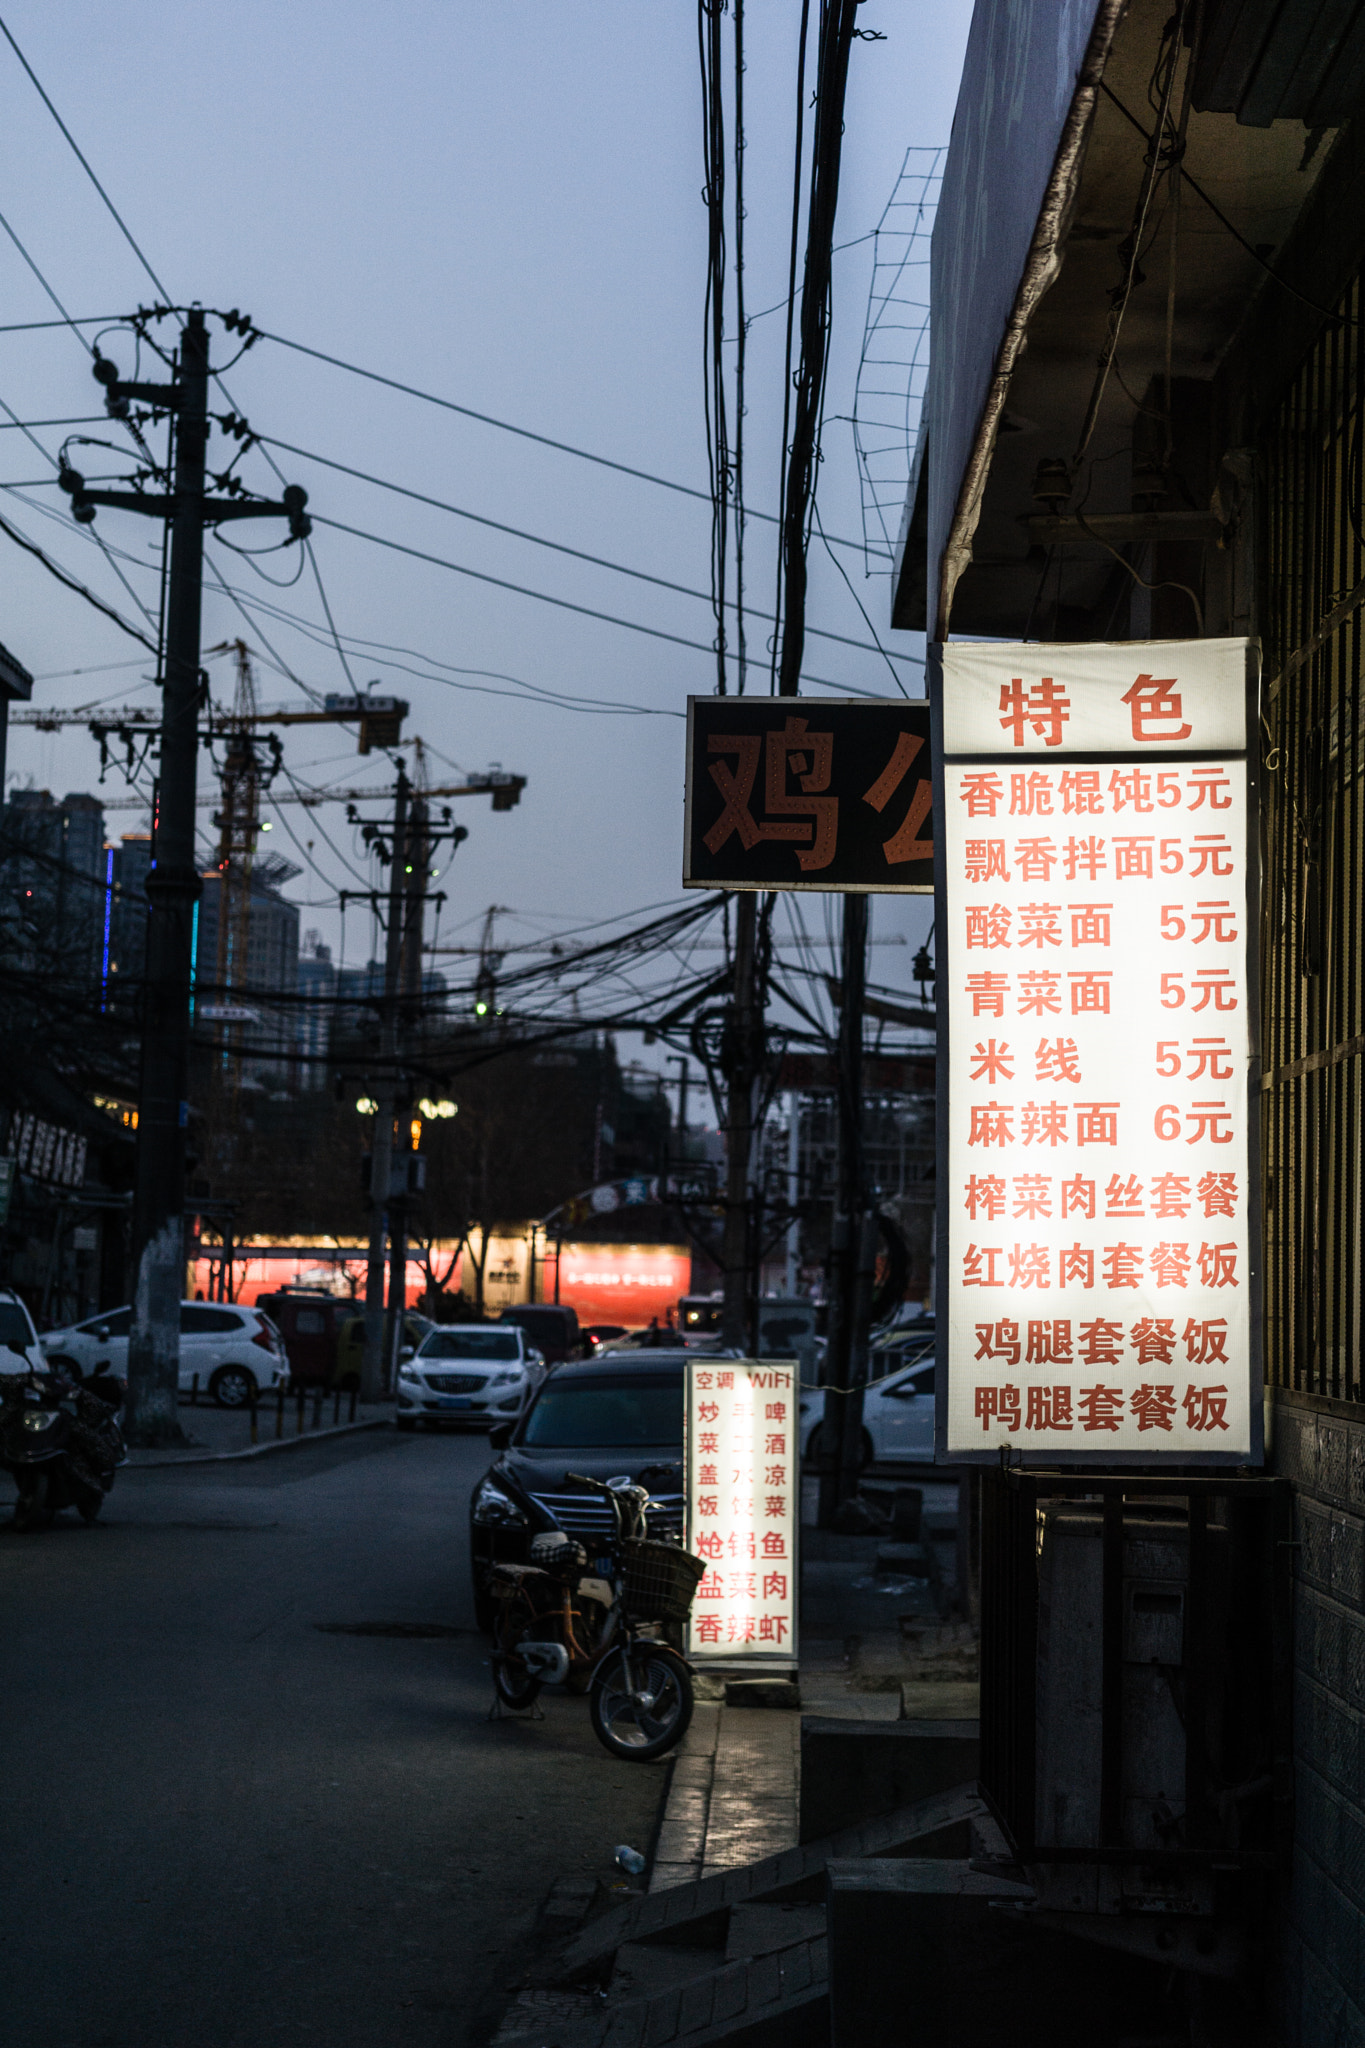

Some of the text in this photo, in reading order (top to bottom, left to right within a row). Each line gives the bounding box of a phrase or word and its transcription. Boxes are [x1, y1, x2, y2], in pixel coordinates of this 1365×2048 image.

[999, 674, 1192, 747] 特色
[960, 768, 1232, 817] 香脆馄饨5元
[965, 834, 1234, 883] 飘香拌面5元
[965, 901, 1238, 949] 酸菜面 5元
[965, 969, 1238, 1018] 青菜面 5元
[969, 1037, 1234, 1084] 米线 5元
[967, 1100, 1234, 1147] 麻辣面 6元
[964, 1171, 1239, 1221] 榨菜肉丝套餐
[962, 1241, 1239, 1289] 红烧肉套餐饭
[974, 1317, 1229, 1366] 鸡腿套餐饭
[696, 1371, 735, 1390] 空调
[975, 1384, 1229, 1432] 鸭腿套餐饭
[695, 1613, 789, 1644] 香辣虾
